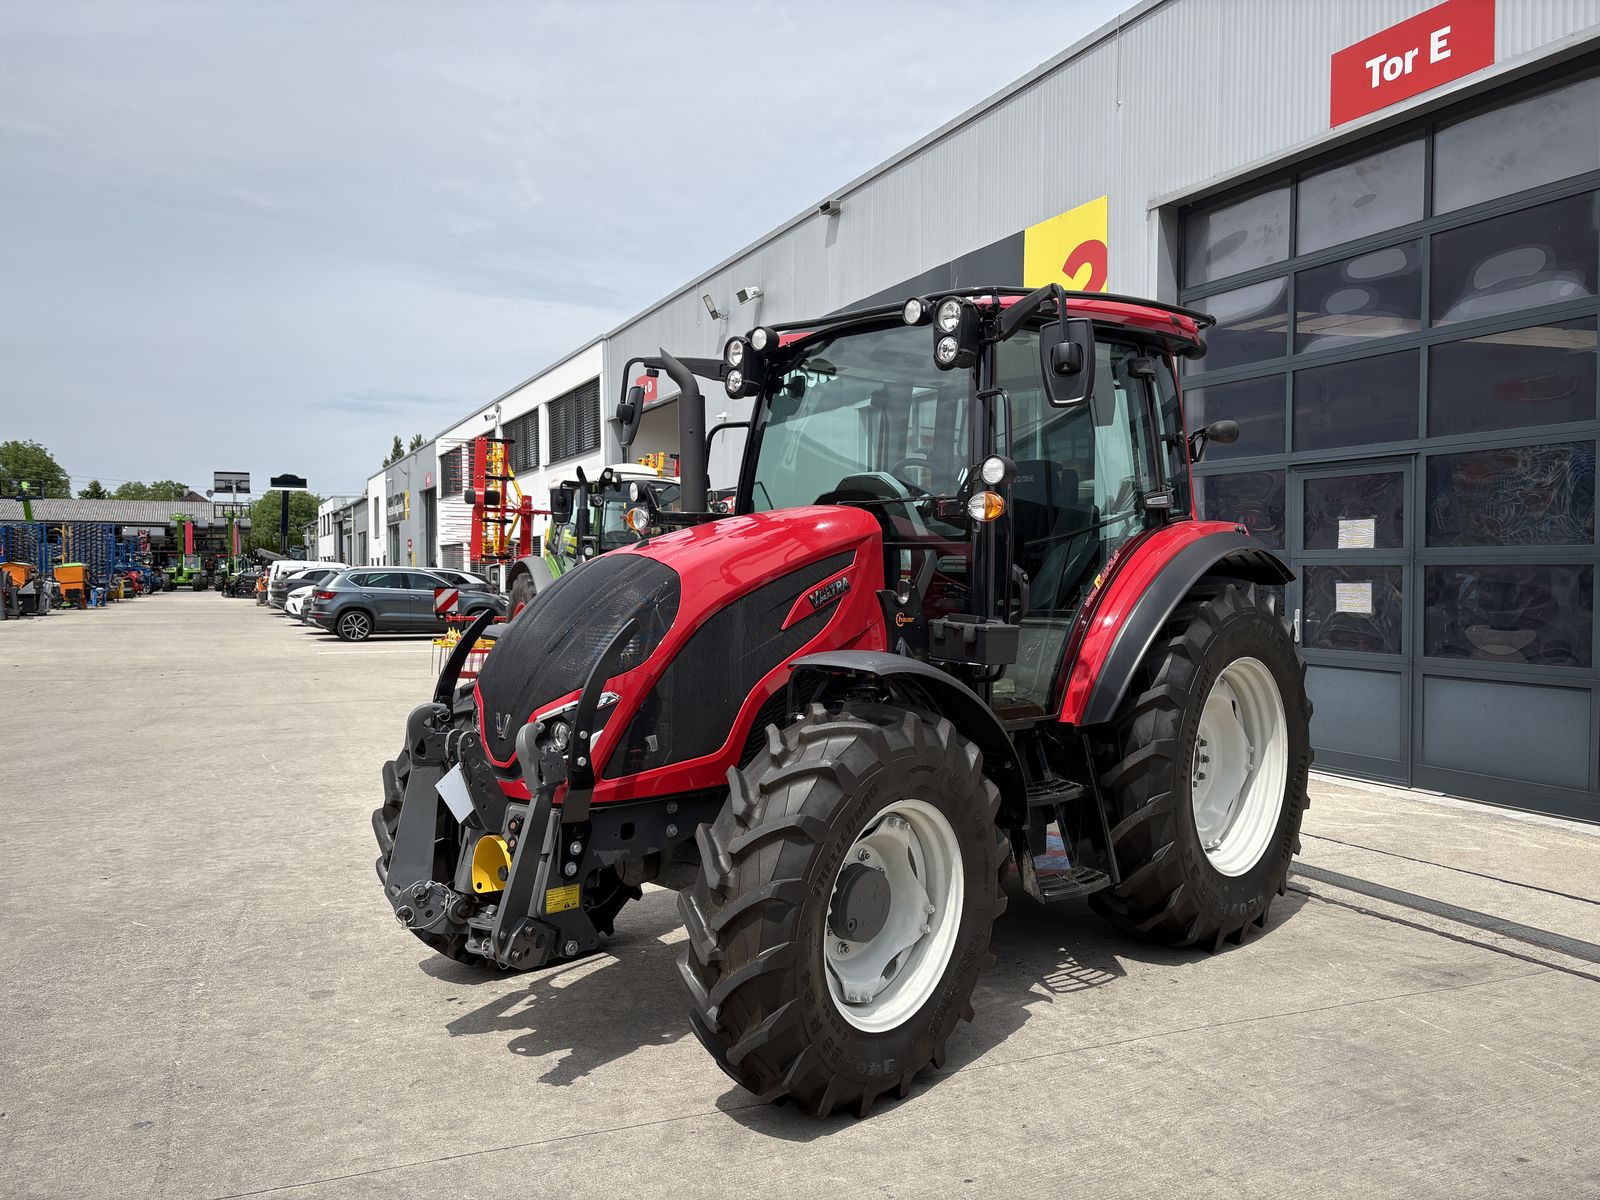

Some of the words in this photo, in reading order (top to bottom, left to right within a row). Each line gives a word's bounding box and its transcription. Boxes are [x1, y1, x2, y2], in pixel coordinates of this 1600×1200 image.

[1365, 47, 1418, 88] Tor
[1429, 25, 1452, 63] E
[1062, 239, 1107, 292] 2
[808, 576, 850, 606] VALTRA
